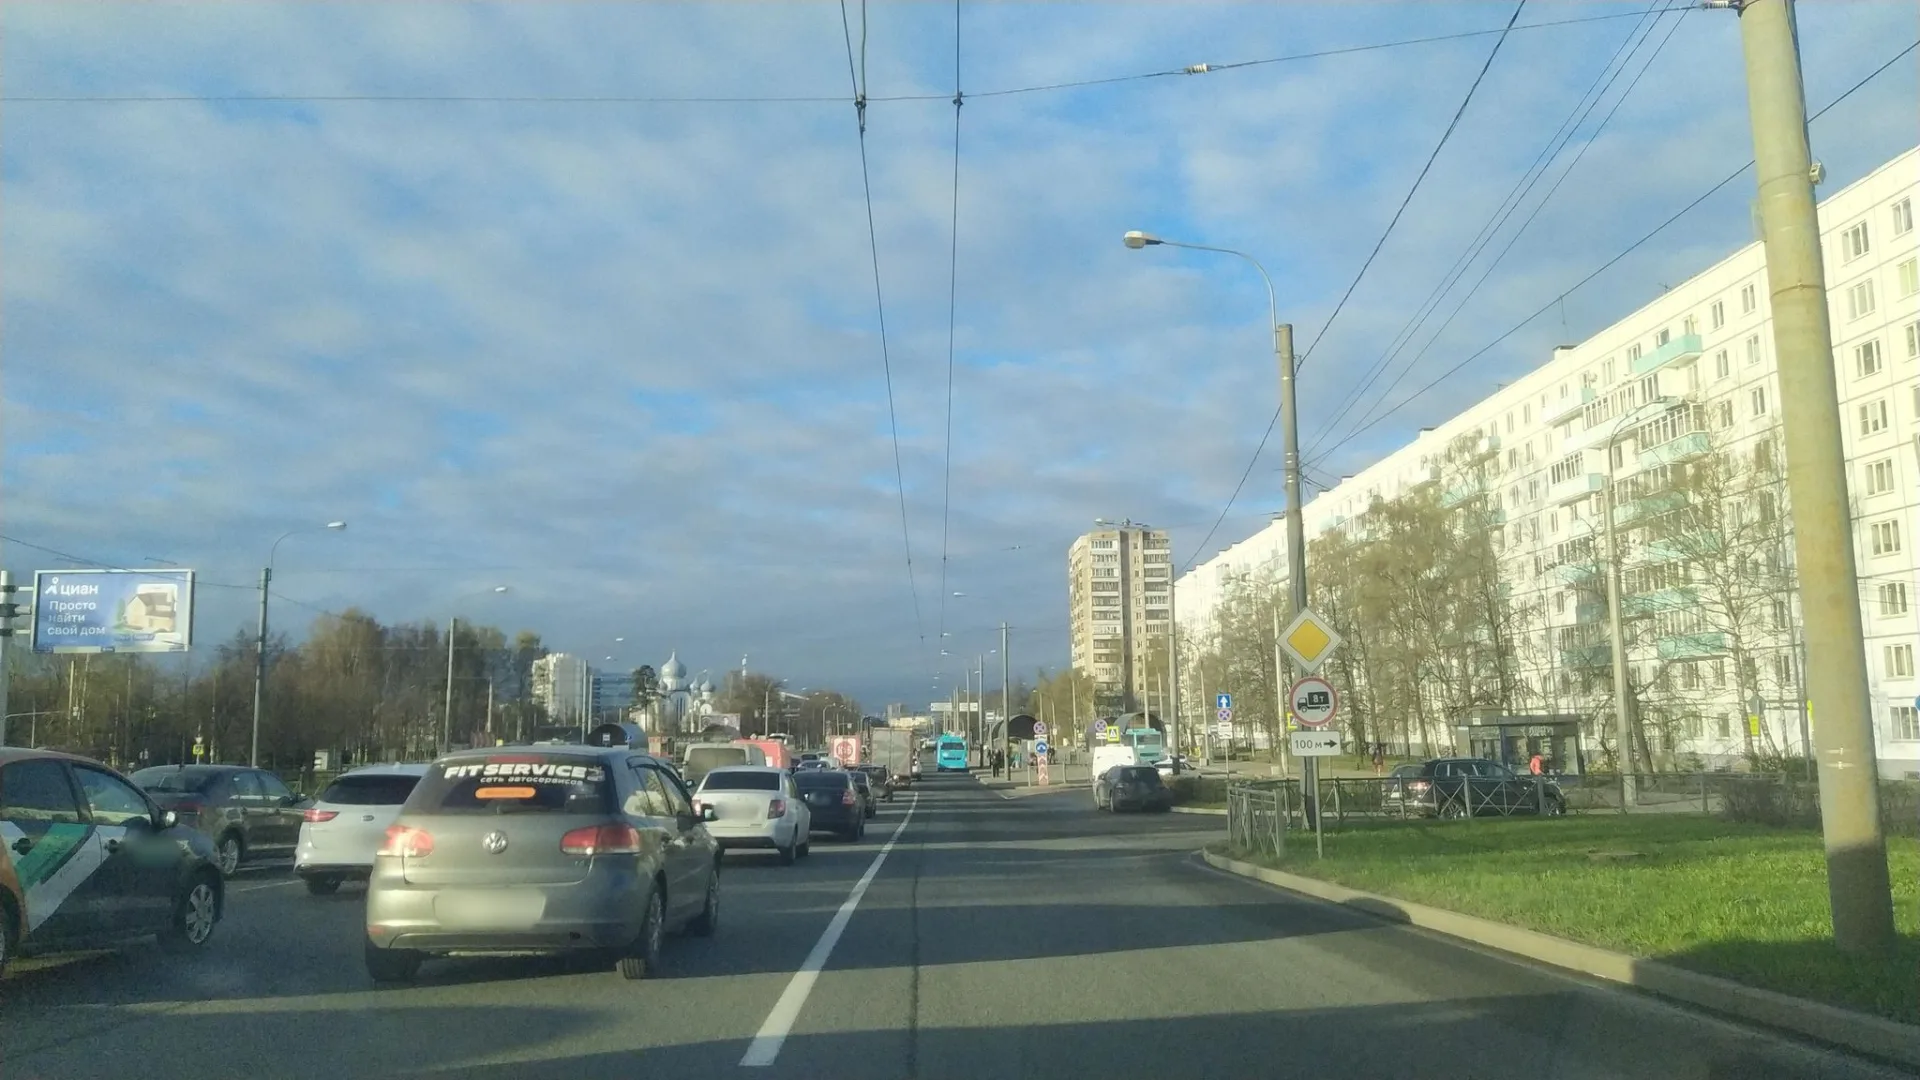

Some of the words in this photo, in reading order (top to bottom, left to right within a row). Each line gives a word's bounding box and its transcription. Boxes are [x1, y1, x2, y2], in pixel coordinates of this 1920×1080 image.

[60, 584, 99, 597] циан
[49, 601, 97, 612] Просто
[48, 613, 86, 623] найти
[47, 625, 78, 636] свой
[80, 627, 106, 637] дом
[1295, 740, 1313, 749] 100
